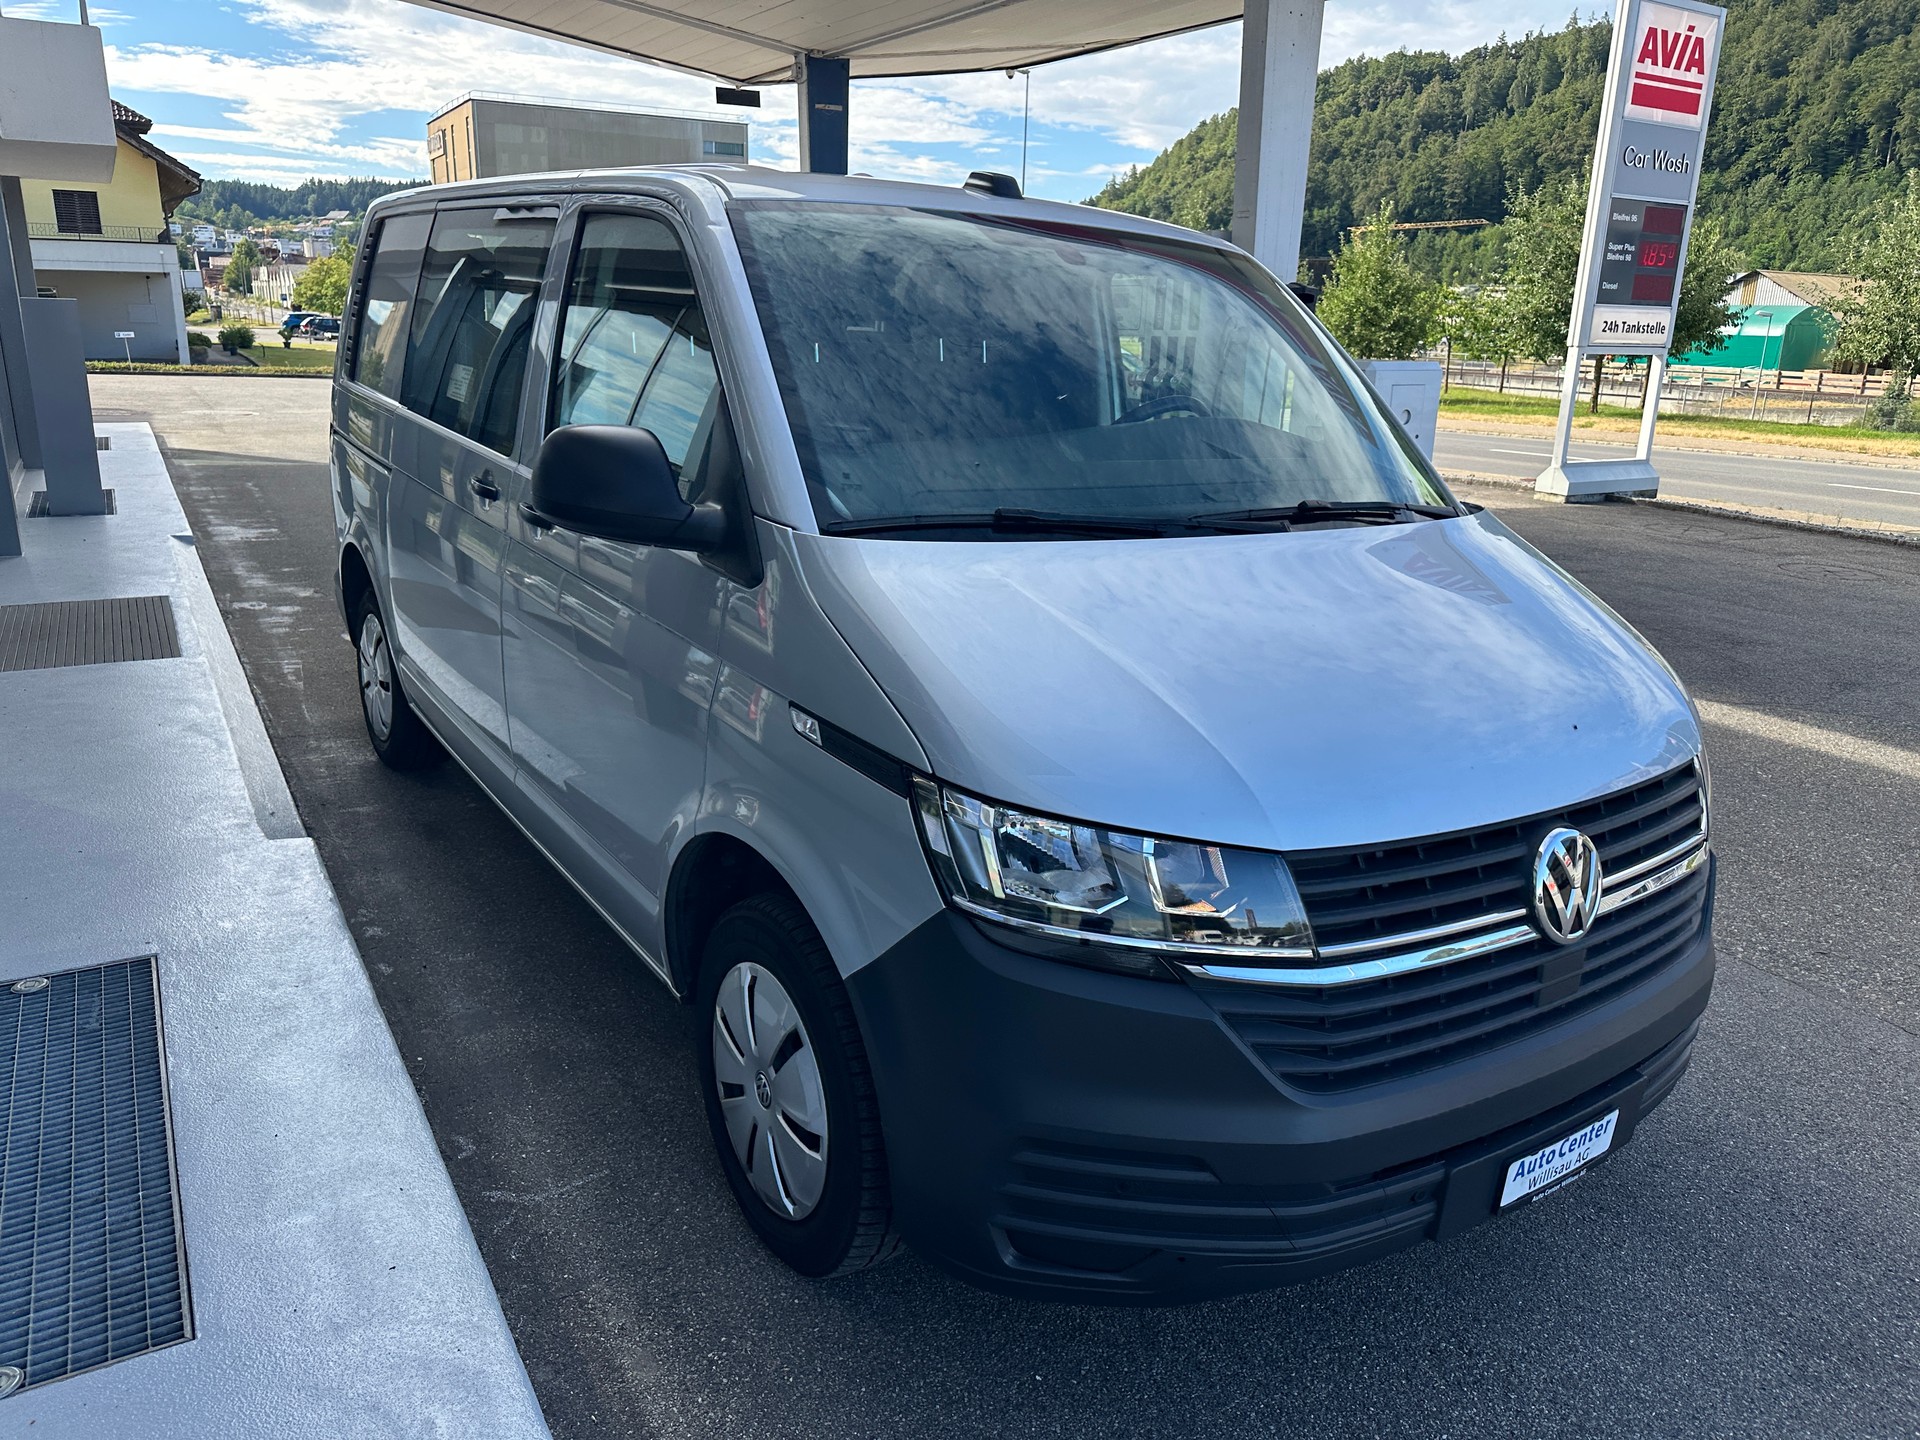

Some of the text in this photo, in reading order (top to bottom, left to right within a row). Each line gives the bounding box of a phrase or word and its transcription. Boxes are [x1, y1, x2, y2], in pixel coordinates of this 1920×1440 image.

[1623, 146, 1690, 173] Car Wash
[1612, 212, 1638, 222] Bleifrei 95
[1608, 242, 1635, 252] Super Plus
[1606, 253, 1625, 261] Bleifrei
[1602, 282, 1618, 290] Diesel
[1601, 320, 1666, 334] 24h Tankstelle
[1528, 1147, 1590, 1190] Willisau AG
